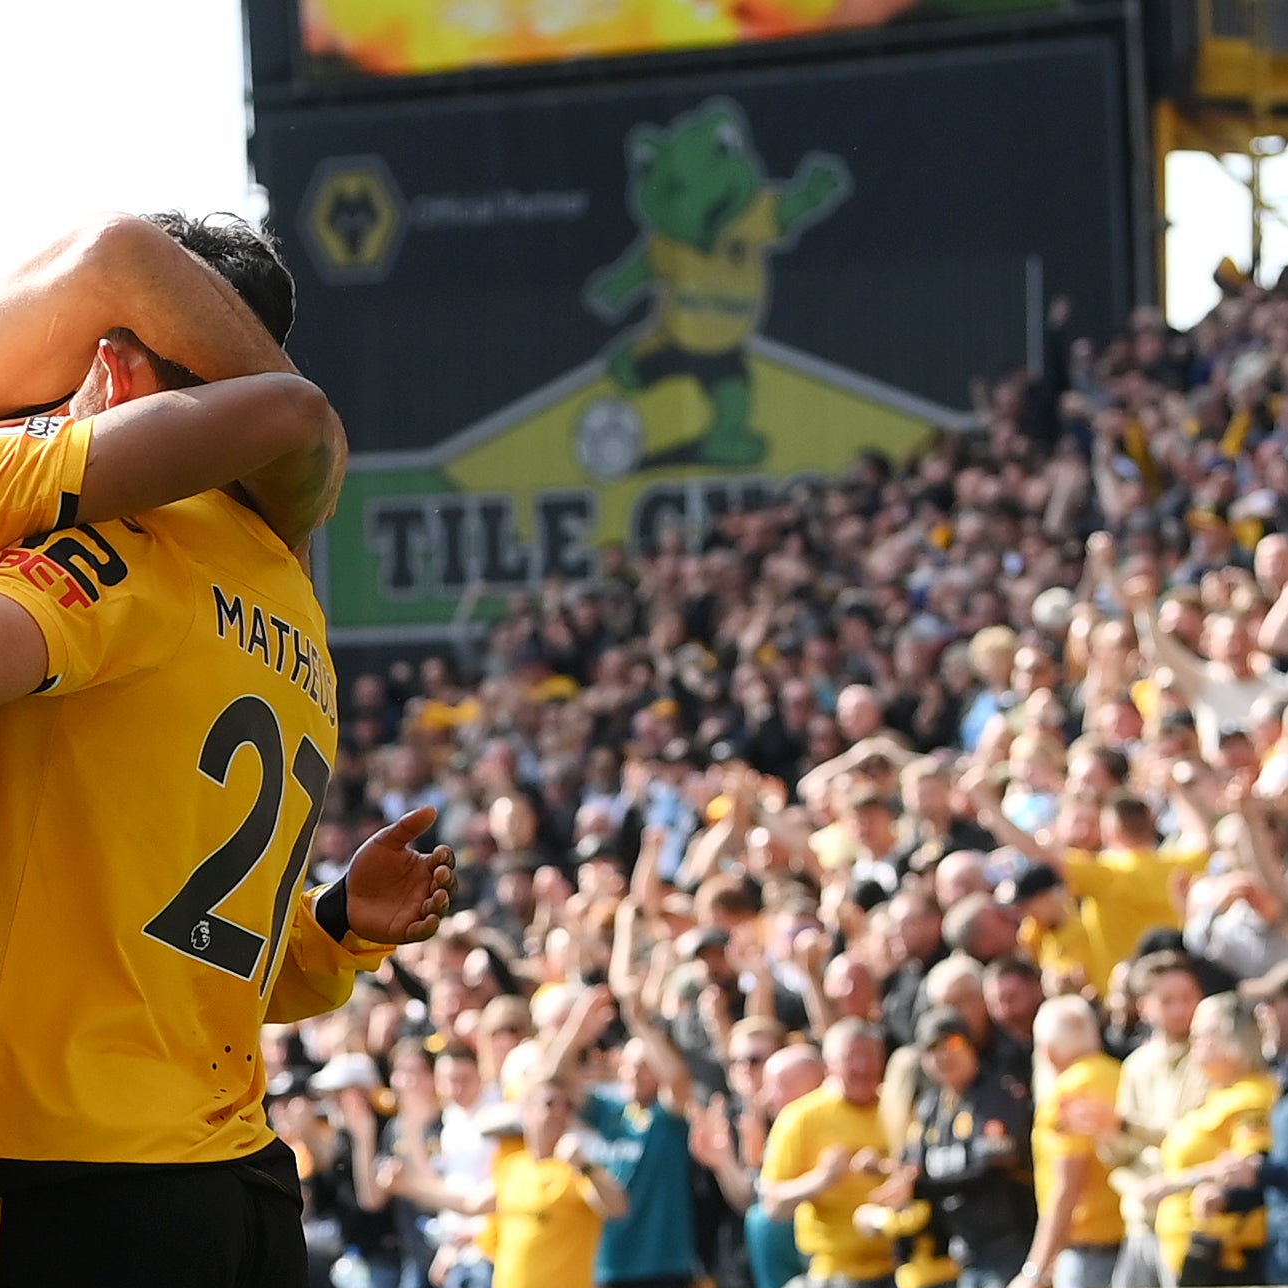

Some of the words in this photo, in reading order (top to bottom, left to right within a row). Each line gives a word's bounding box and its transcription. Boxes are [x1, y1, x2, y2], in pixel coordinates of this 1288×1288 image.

[368, 490, 595, 592] TILE
[211, 583, 337, 728] MATHEUS
[142, 694, 332, 1000] 27
